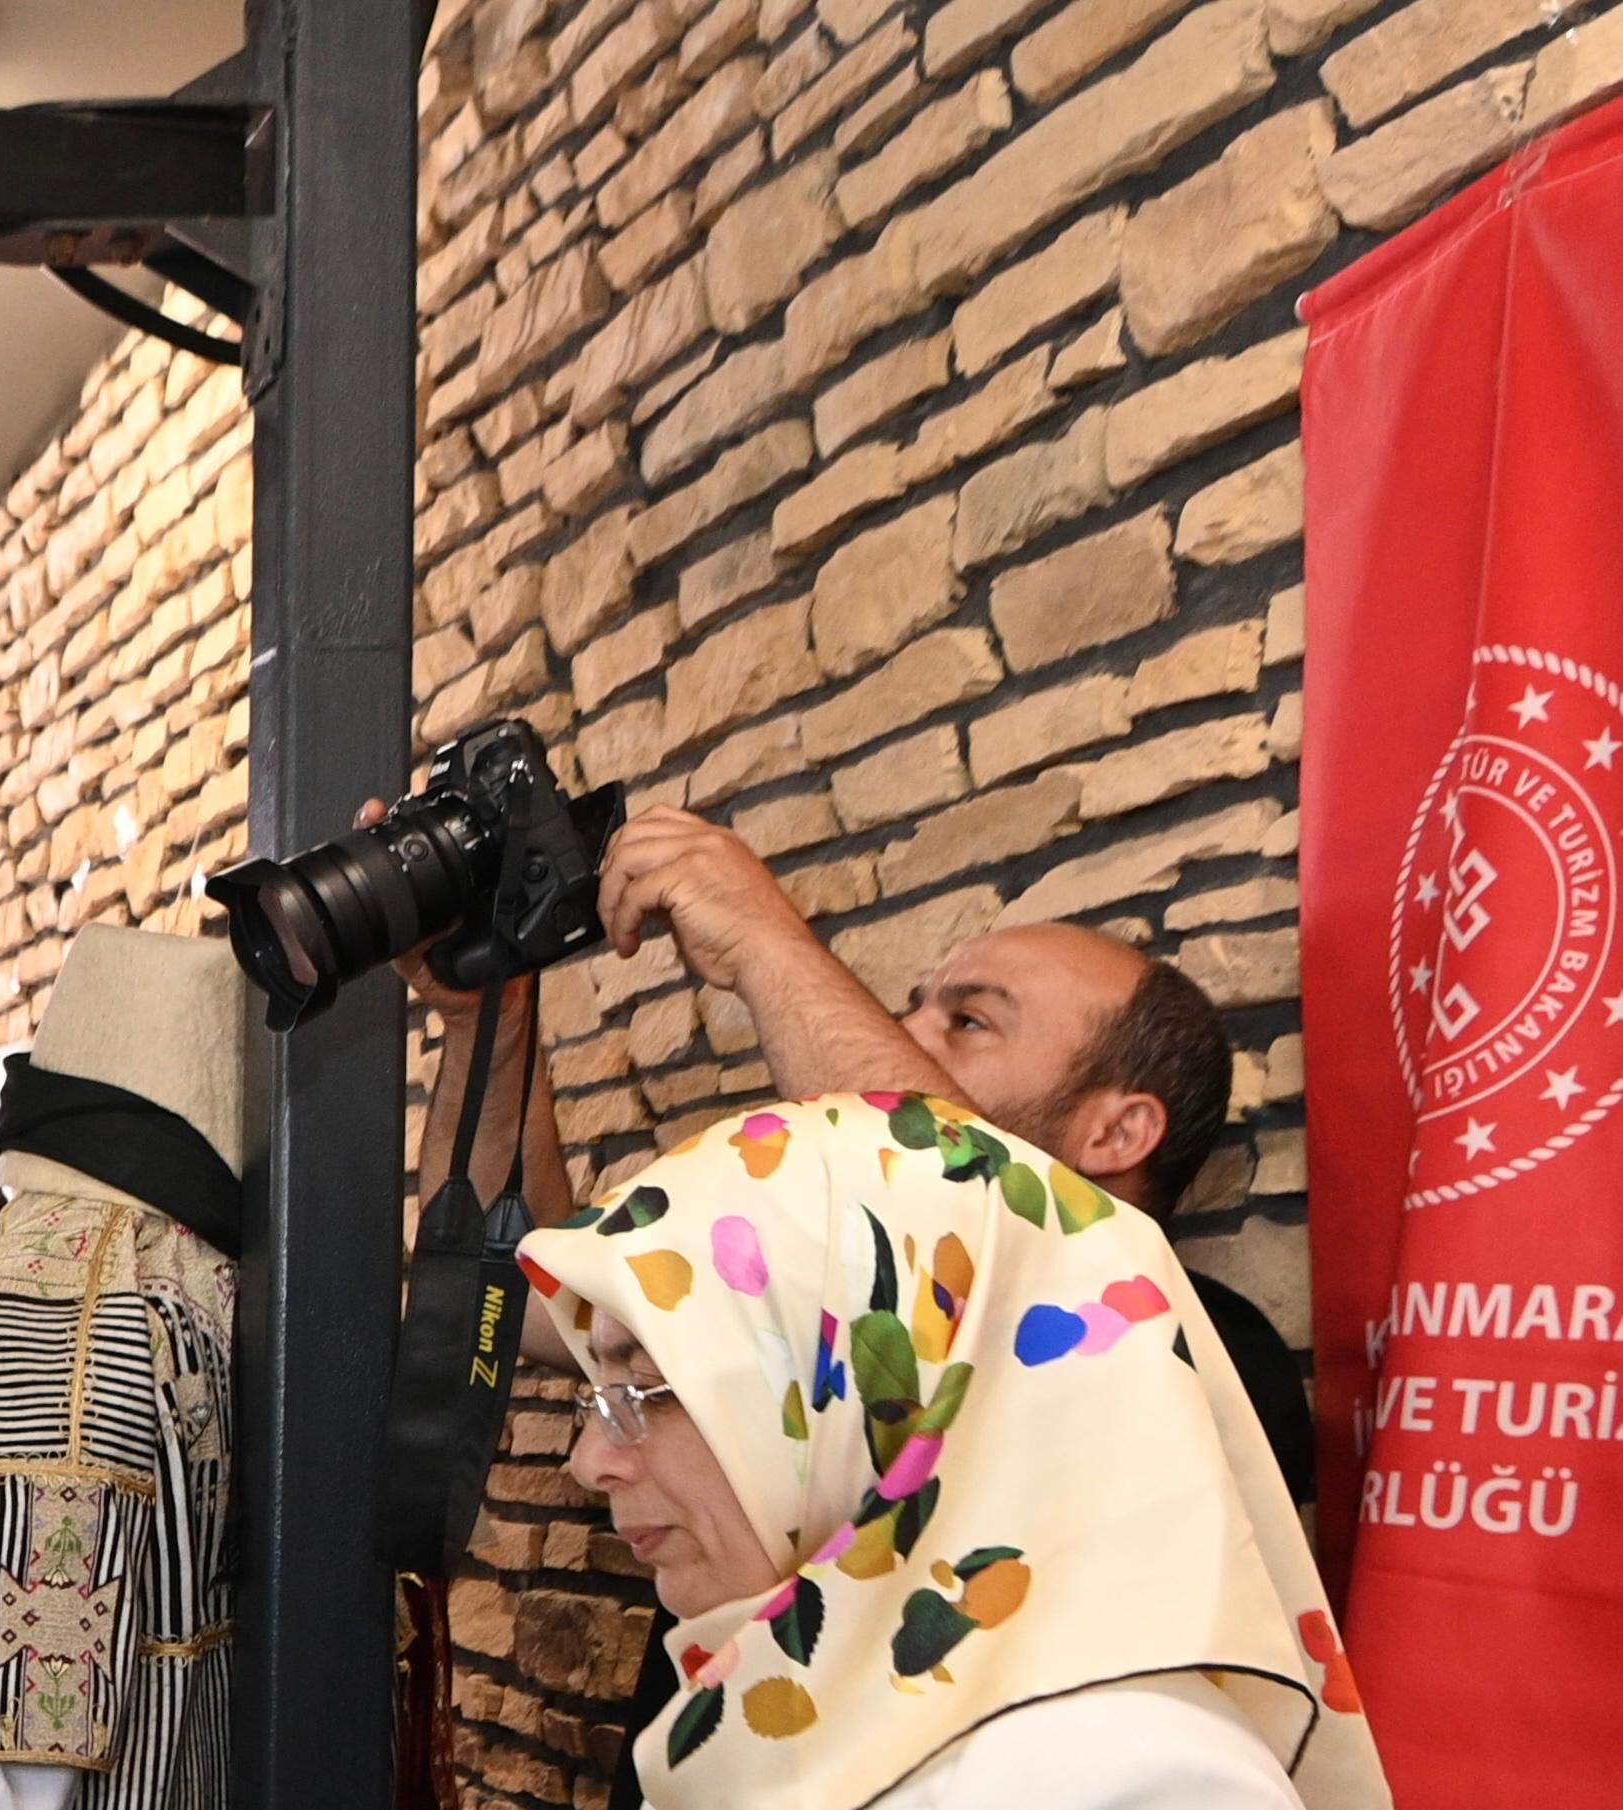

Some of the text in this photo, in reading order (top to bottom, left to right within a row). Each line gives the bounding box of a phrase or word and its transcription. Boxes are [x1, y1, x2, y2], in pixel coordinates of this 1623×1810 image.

[1512, 768, 1557, 813] VE
[1548, 803, 1604, 938] TURİZM
[1434, 949, 1590, 1099] BAKANLIĞI
[469, 1284, 505, 1389] Nikon Z
[1451, 1369, 1623, 1442] TURİ
